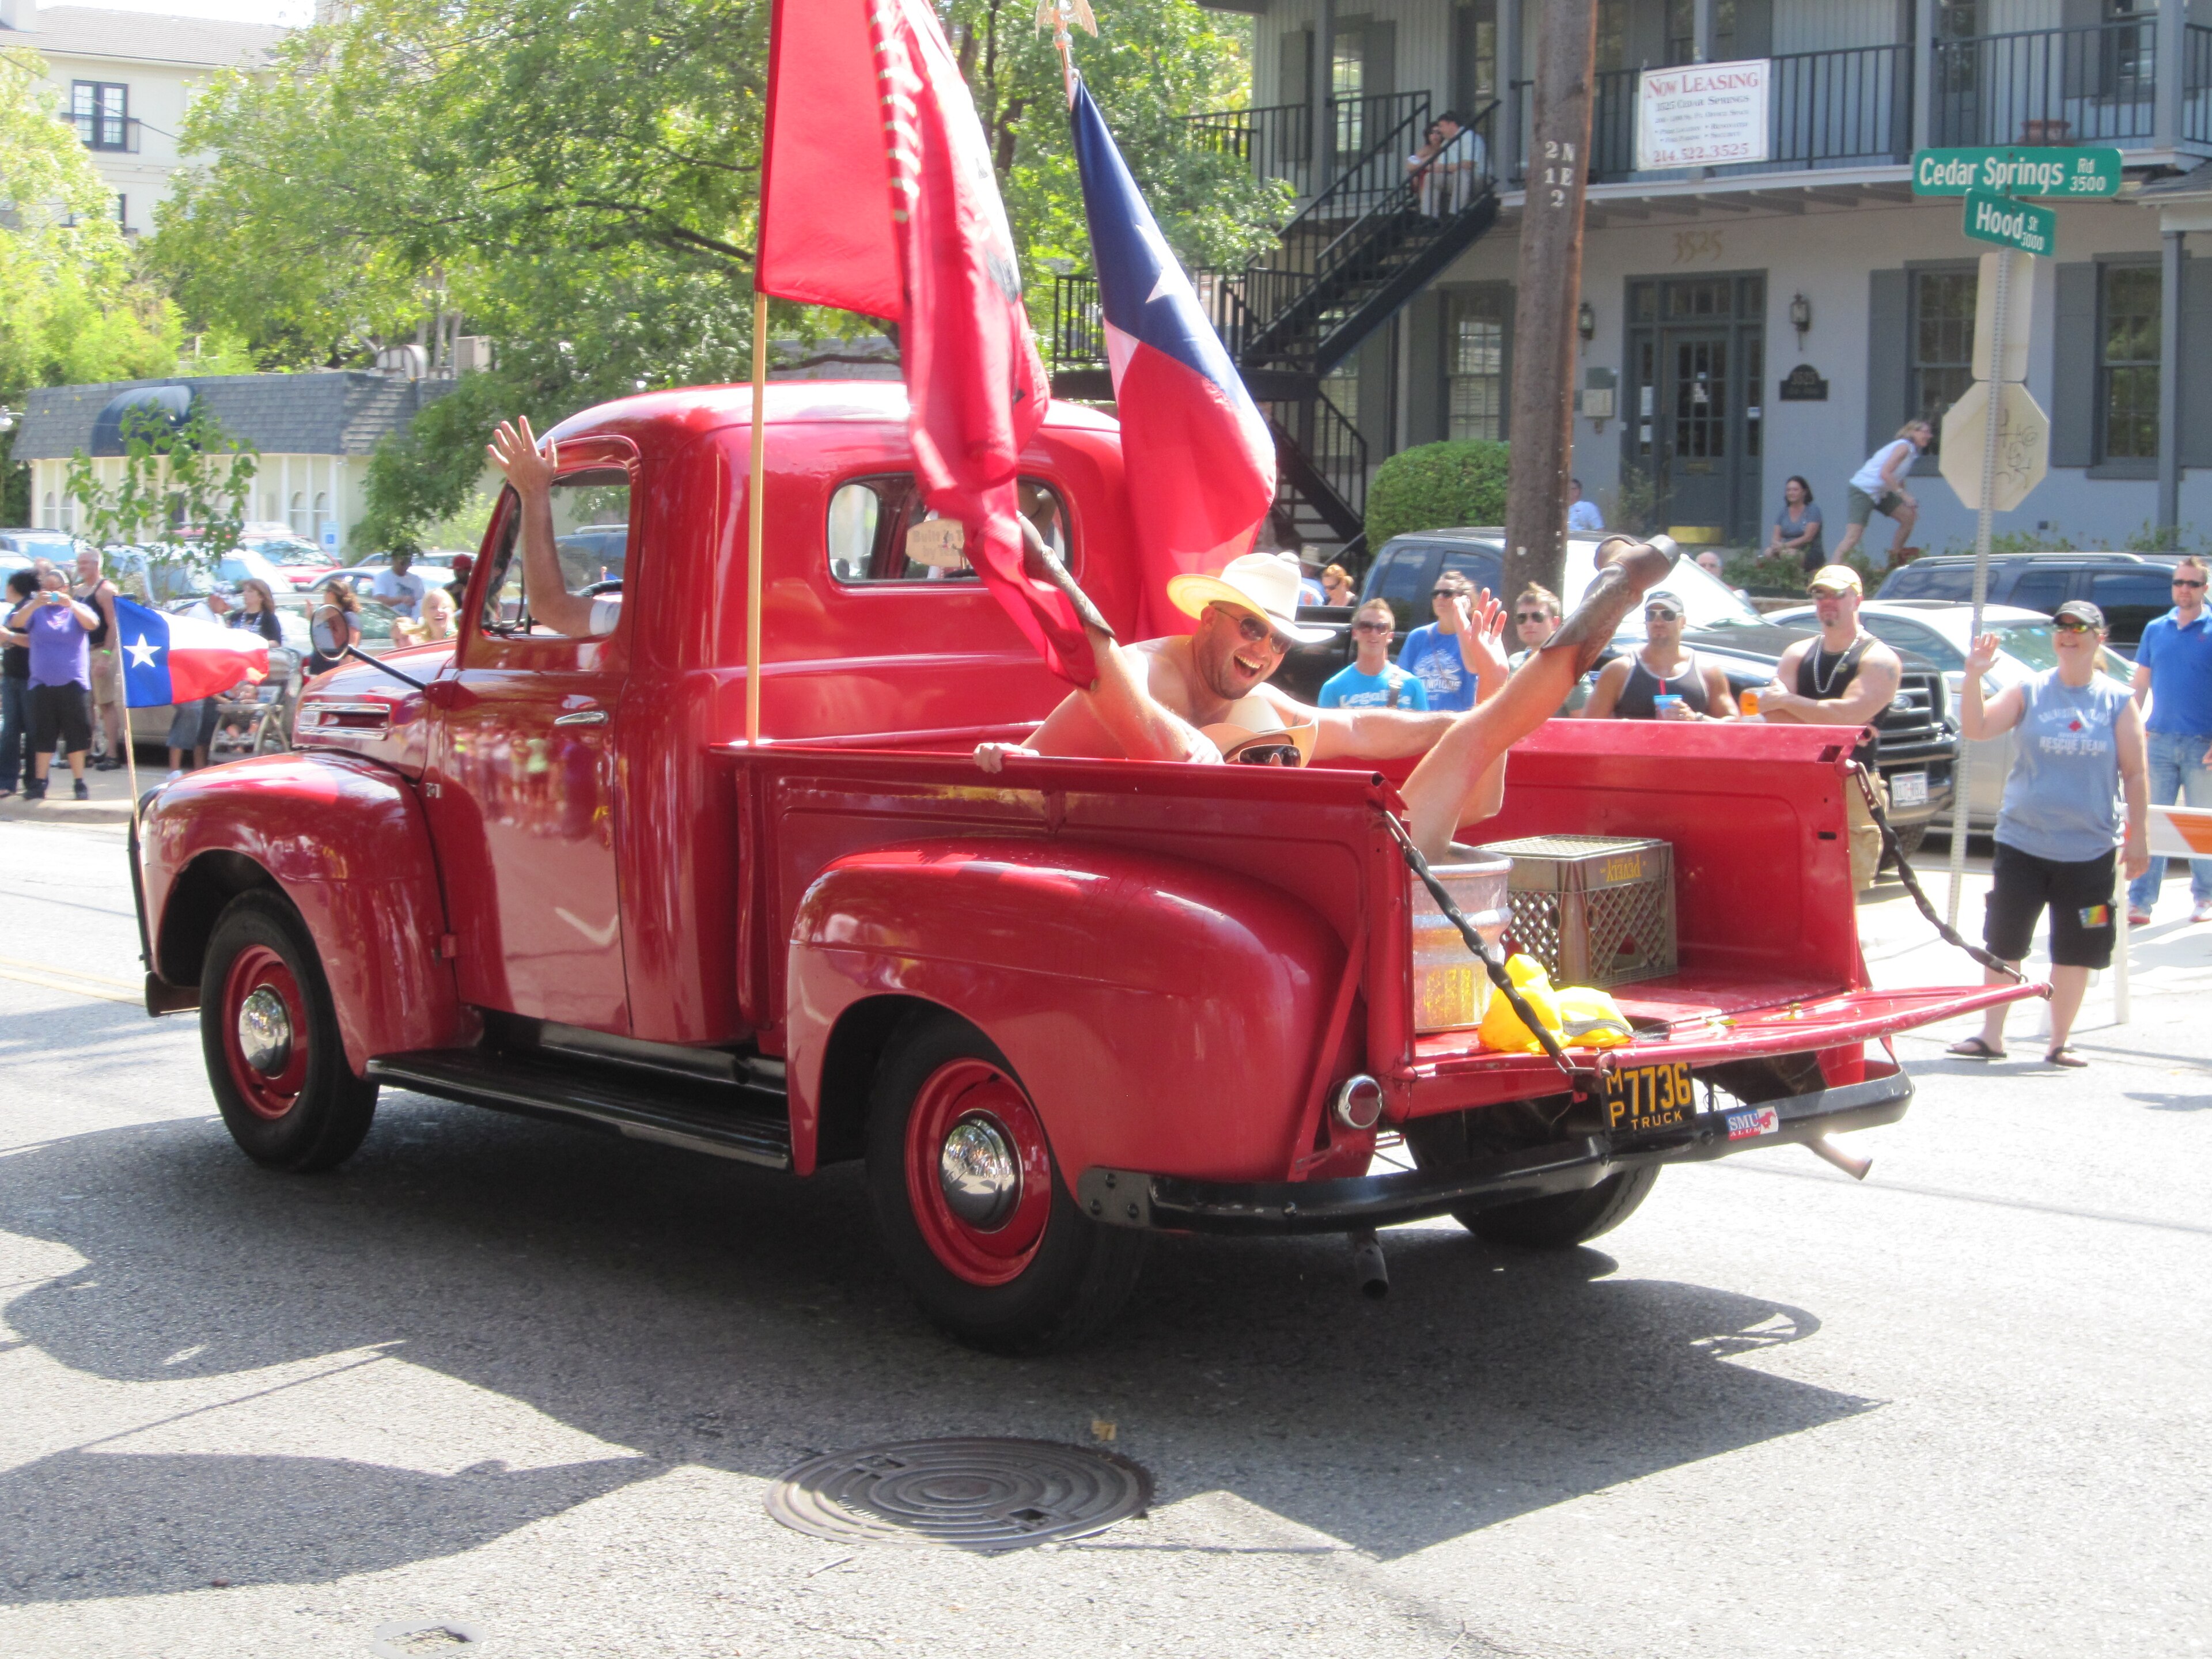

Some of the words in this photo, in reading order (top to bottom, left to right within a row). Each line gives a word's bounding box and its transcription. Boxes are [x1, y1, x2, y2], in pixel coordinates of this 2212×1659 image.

[1919, 157, 1978, 186] Cedar
[1983, 156, 2065, 194] Springs
[2077, 158, 2096, 174] Rd
[2069, 176, 2107, 192] 3500
[1550, 190, 1565, 207] 2
[1976, 202, 2025, 240] Hood
[2028, 216, 2038, 232] St
[2021, 232, 2044, 251] 3000
[1624, 1062, 1692, 1116] 7736
[1631, 1109, 1683, 1131] TRUCK
[1728, 1113, 1759, 1131] SMU
[1730, 1127, 1761, 1137] ALUM
